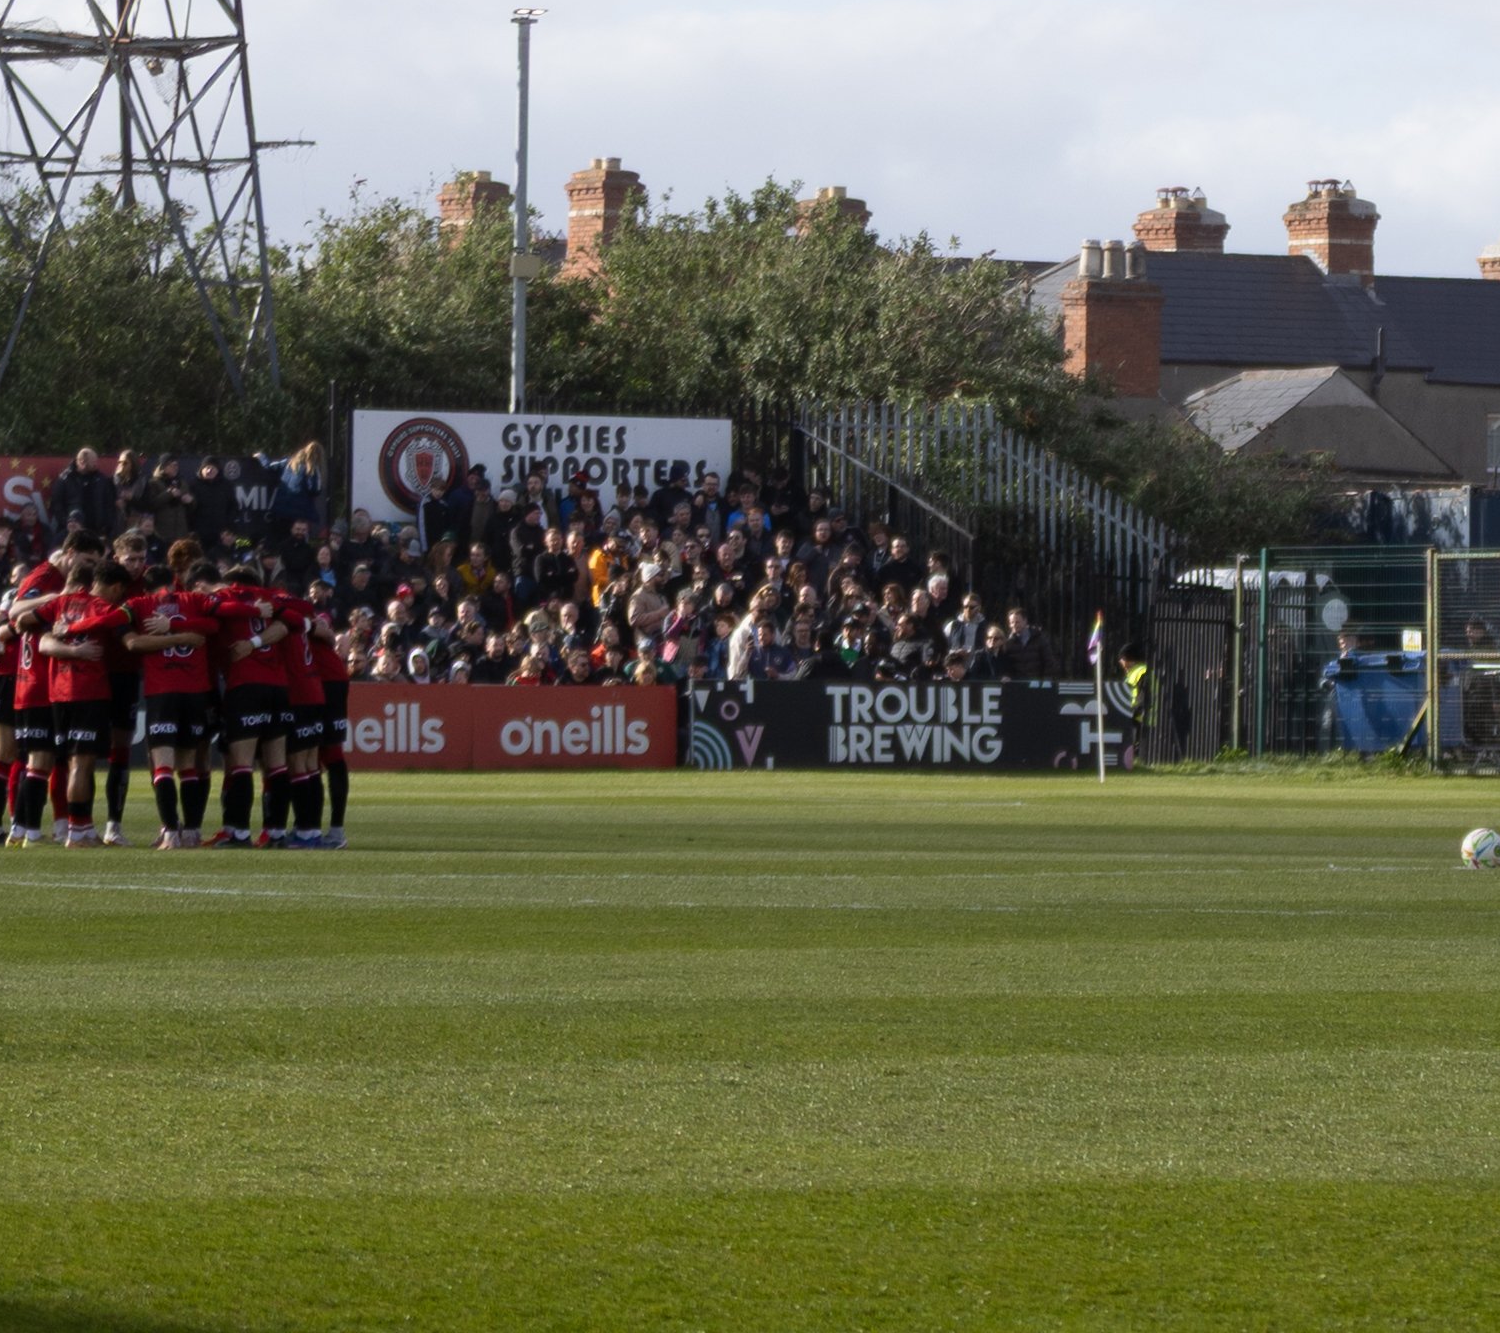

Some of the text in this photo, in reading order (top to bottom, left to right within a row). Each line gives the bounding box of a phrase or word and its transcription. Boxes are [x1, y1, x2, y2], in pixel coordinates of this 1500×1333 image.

[501, 422, 628, 454] GYPSIES
[501, 454, 707, 488] SUPPORTES
[825, 685, 1003, 724] TROUBLE
[828, 725, 1003, 763] BREWING
